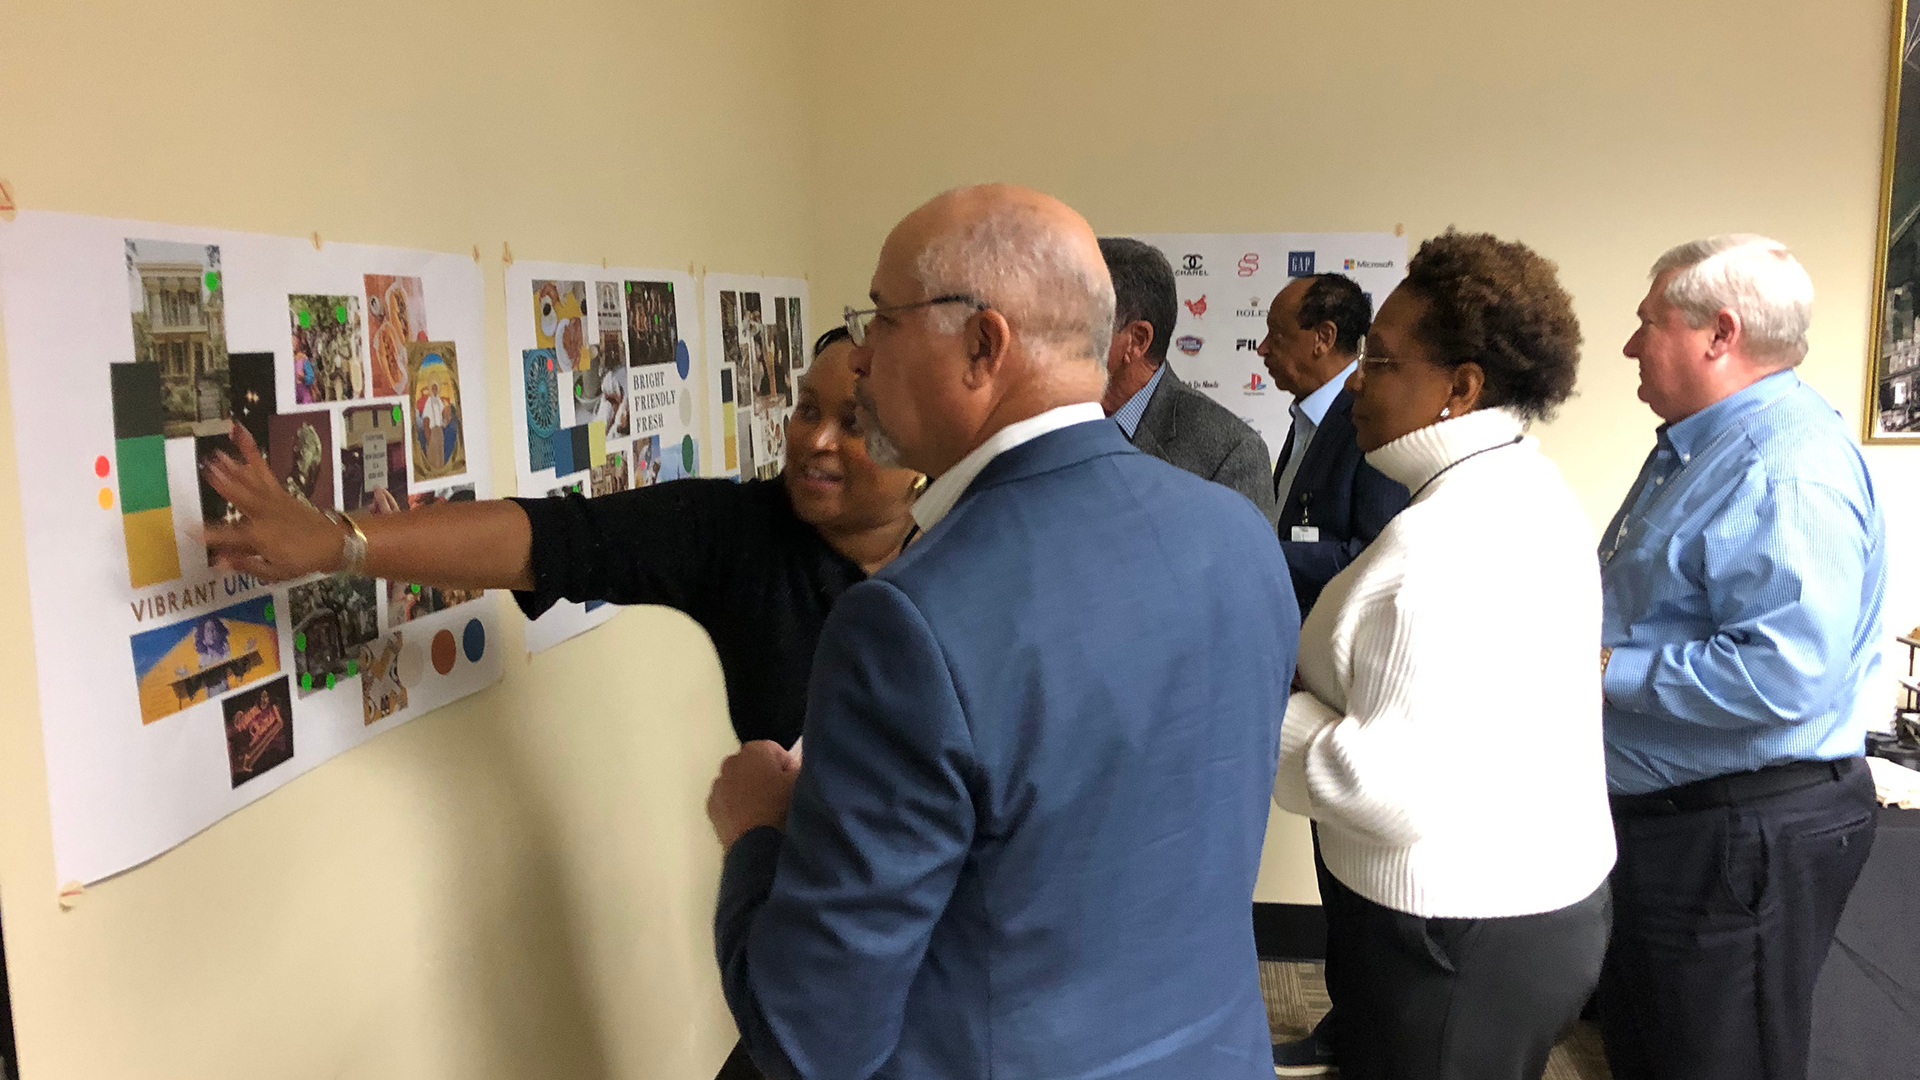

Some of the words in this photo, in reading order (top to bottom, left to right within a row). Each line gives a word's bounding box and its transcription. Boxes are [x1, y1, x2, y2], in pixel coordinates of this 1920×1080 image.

[1292, 256, 1311, 272] GAP
[1356, 261, 1395, 269] Microsoft
[1175, 269, 1209, 277] CHANEL
[1236, 309, 1269, 318] ROLE
[1236, 337, 1258, 351] FIL
[633, 371, 665, 391] BRIGHT
[634, 389, 676, 412] FRIENDLY
[636, 413, 664, 434] FRESH
[131, 581, 216, 622] VIBRANT
